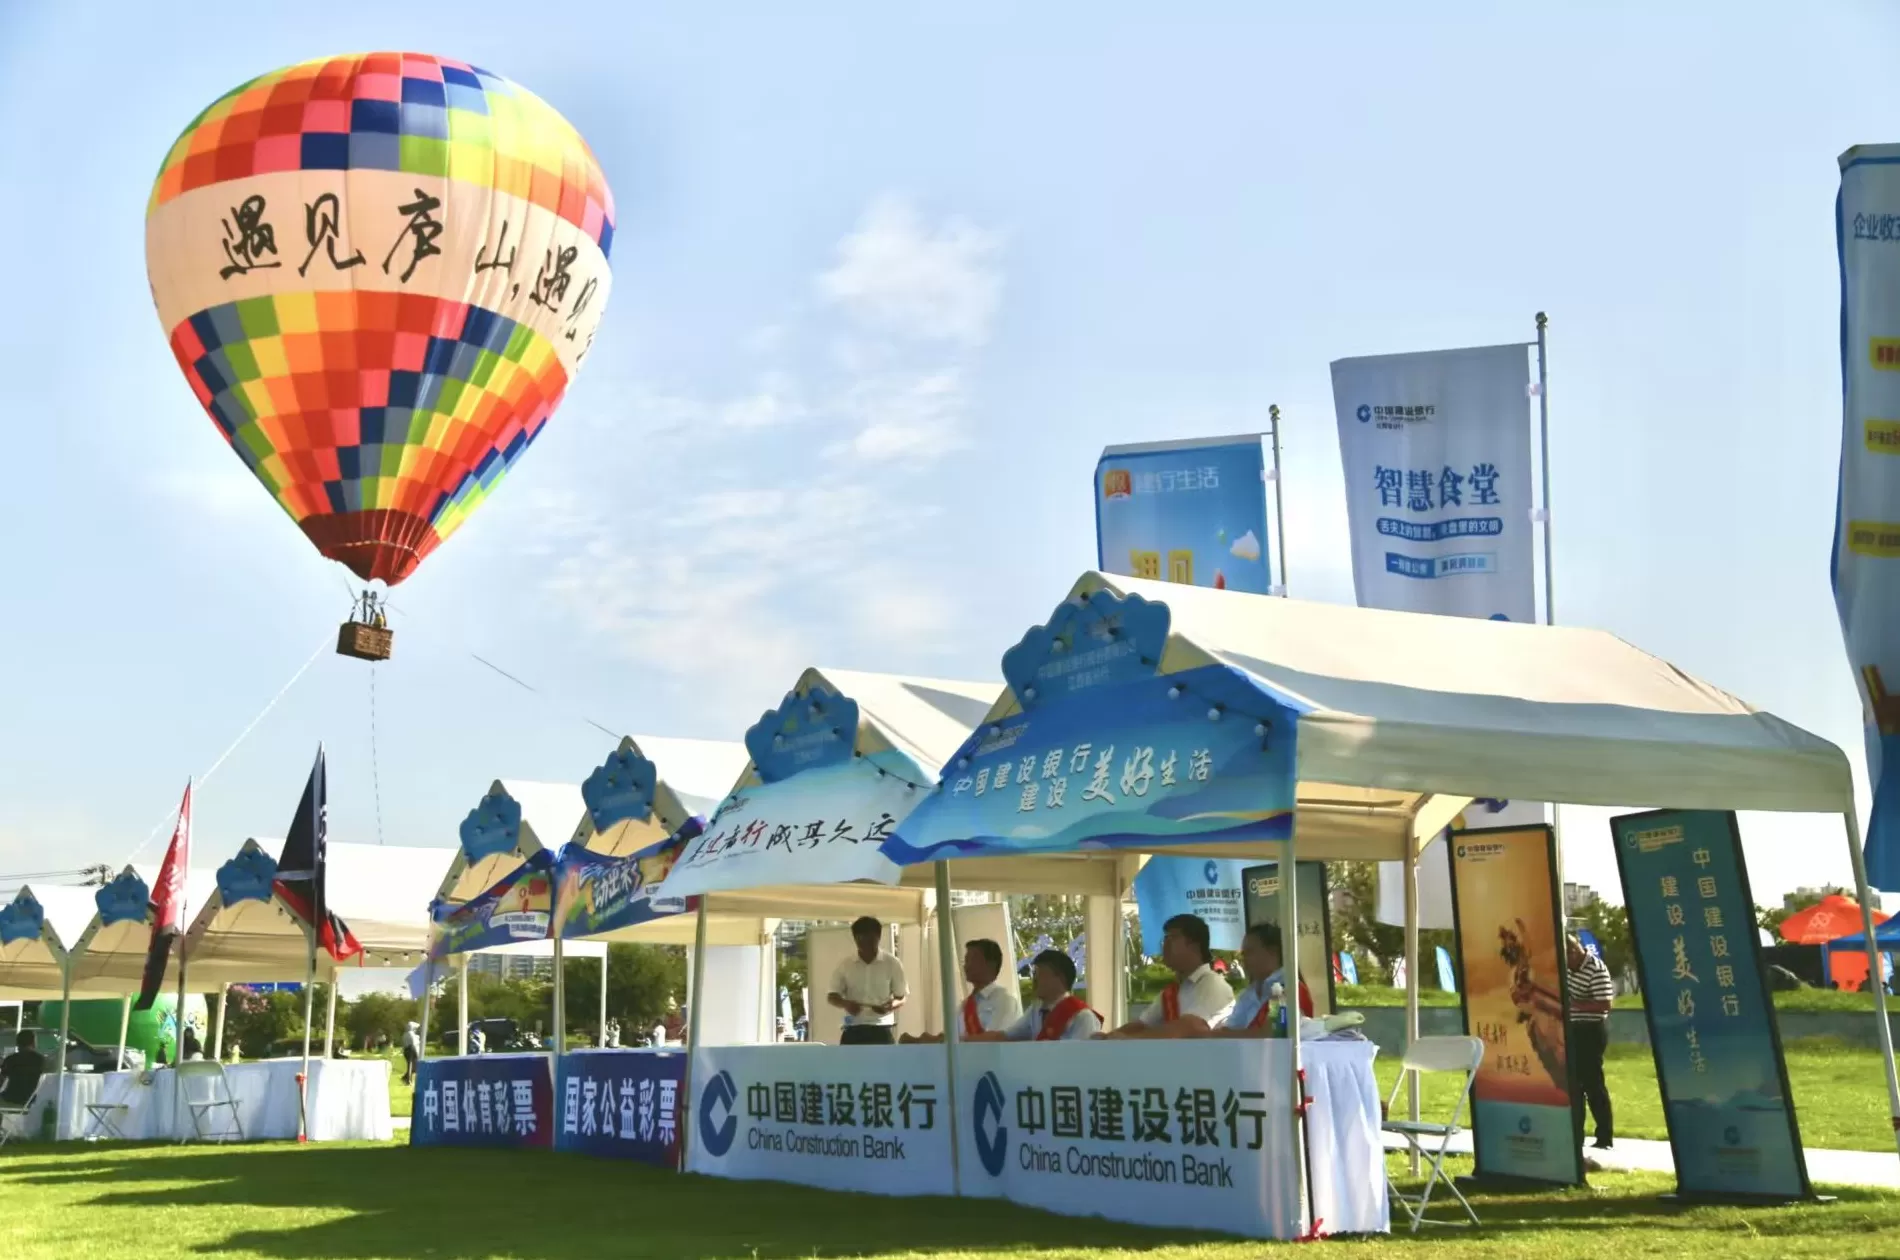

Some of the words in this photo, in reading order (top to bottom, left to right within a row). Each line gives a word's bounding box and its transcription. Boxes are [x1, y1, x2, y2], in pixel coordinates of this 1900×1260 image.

[219, 187, 597, 362] 遇见庐山,遇见
[1374, 463, 1501, 512] 智慧食堂
[952, 743, 1092, 797] 中国建设银行
[1017, 744, 1212, 814] 建设美好生活
[1693, 848, 1740, 1016] 中国建设银行
[1660, 876, 1706, 1072] 建设美好生活
[423, 1079, 537, 1136] 中国体育彩票
[563, 1076, 678, 1146] 国家公益彩票
[747, 1081, 937, 1130] 中国建设银行
[1016, 1086, 1267, 1150] 中国建设银行
[748, 1127, 782, 1151] China
[786, 1129, 859, 1158] Construction
[863, 1134, 906, 1160] Bank
[1019, 1142, 1061, 1173] China
[1066, 1146, 1176, 1183] Construction
[1182, 1153, 1234, 1188] Bank
